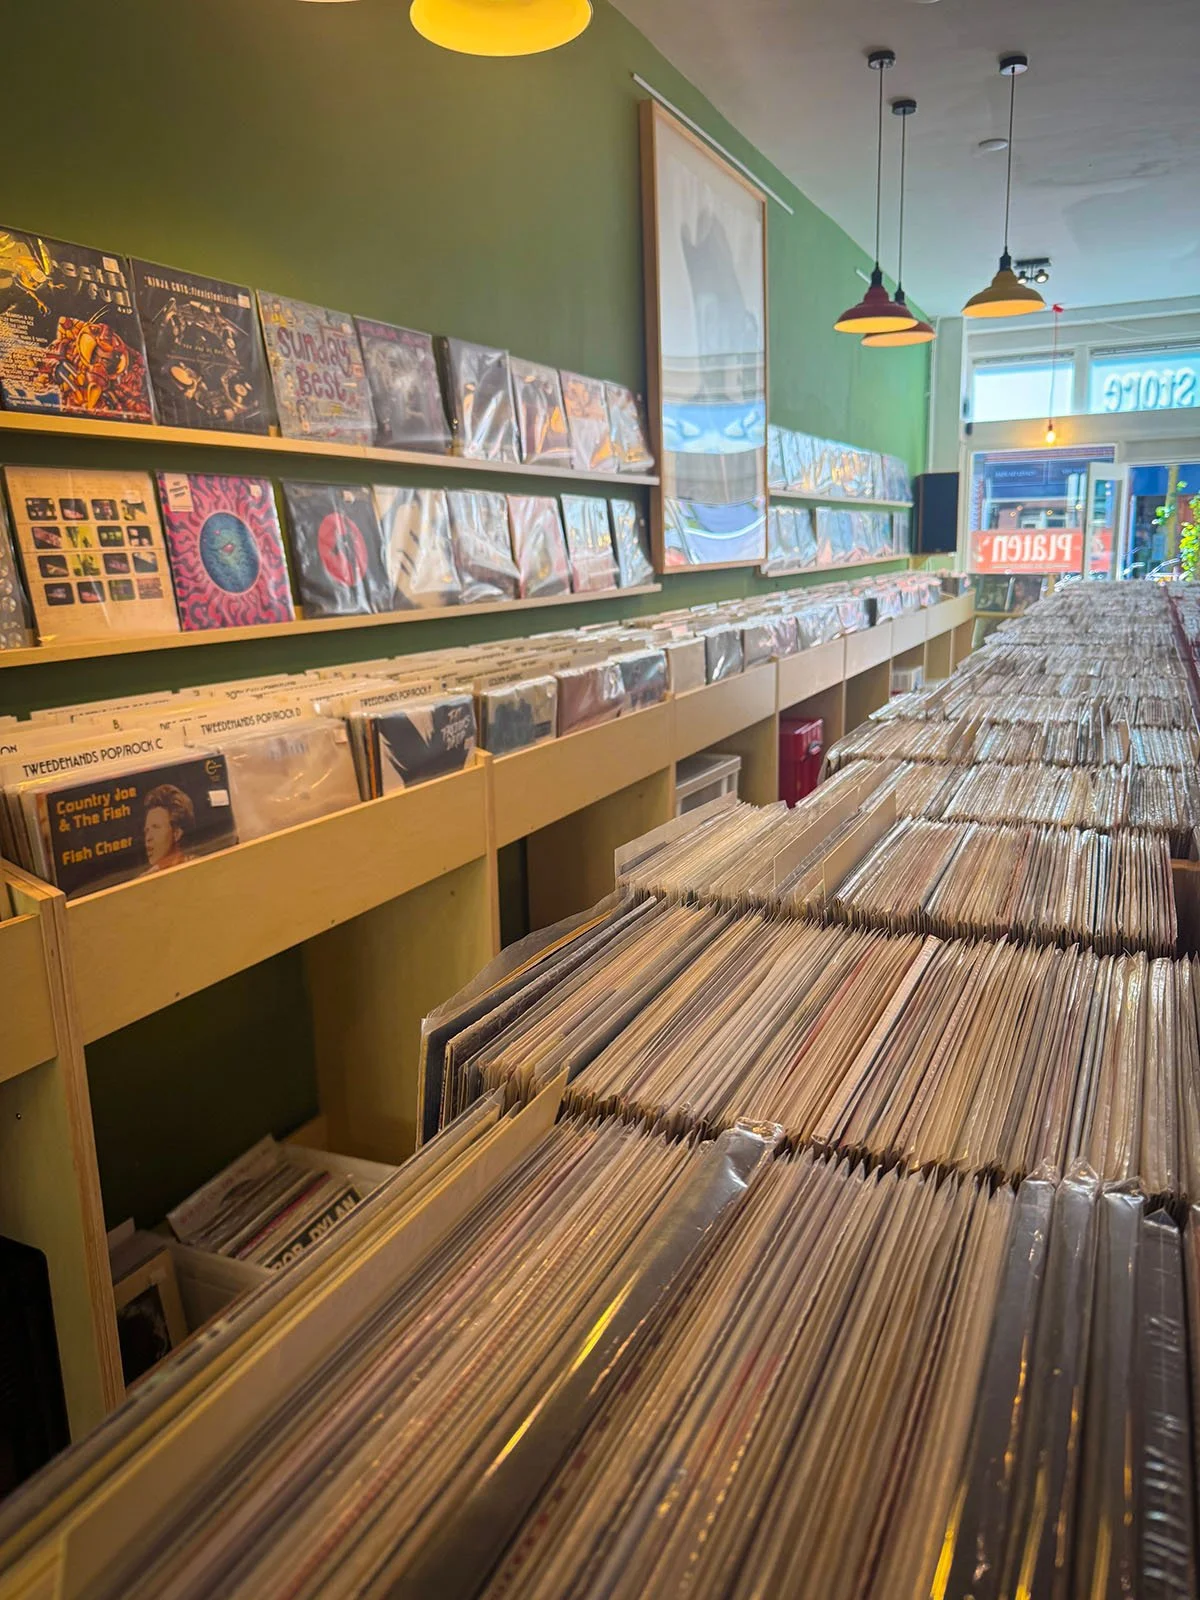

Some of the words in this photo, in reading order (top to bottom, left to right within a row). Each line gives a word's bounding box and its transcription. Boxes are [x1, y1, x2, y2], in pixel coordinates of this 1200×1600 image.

[277, 327, 352, 378] Sunday
[296, 365, 346, 401] Best
[201, 715, 255, 735] TWEEDEHANDS
[22, 752, 99, 778] TWEEDEHANDS
[100, 741, 153, 762] POP/ROCK
[155, 738, 163, 750] C
[56, 793, 110, 815] Country
[114, 787, 137, 801] Joe
[59, 818, 71, 832] &
[72, 813, 99, 828] The
[103, 804, 131, 822] Fish
[62, 846, 93, 866] Fish
[95, 837, 132, 856] Cheer
